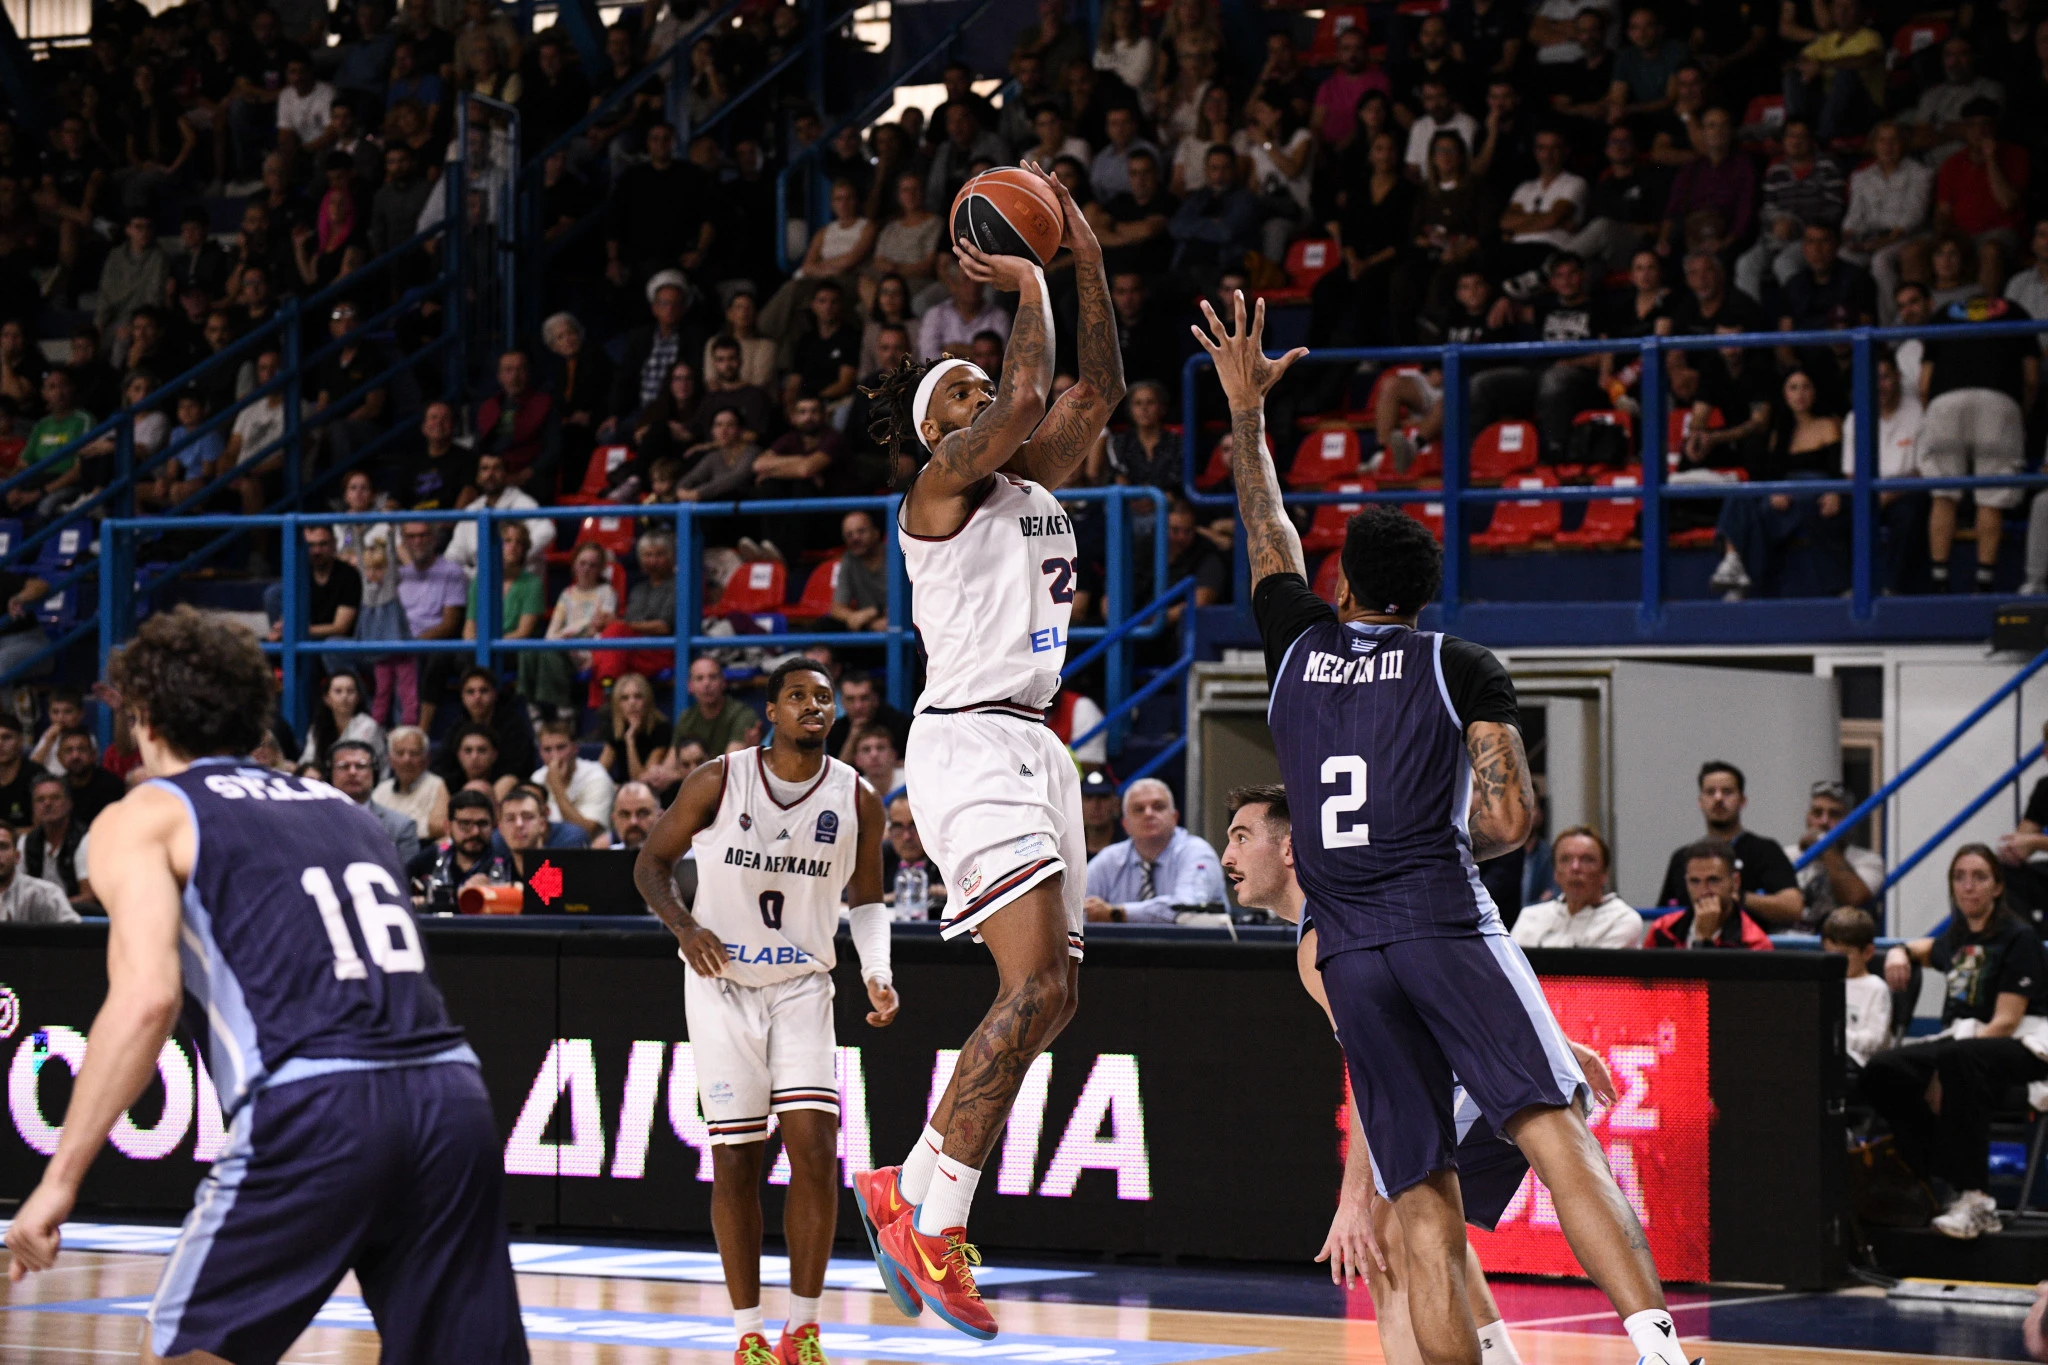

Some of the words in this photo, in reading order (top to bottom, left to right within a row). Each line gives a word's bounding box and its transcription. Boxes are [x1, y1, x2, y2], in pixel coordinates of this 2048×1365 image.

[1302, 650, 1377, 685] MELVIN
[1379, 649, 1404, 681] III
[1321, 755, 1370, 849] 2
[724, 847, 761, 870] ΔΟΞΑ
[301, 862, 425, 980] 16
[759, 890, 785, 930] 0
